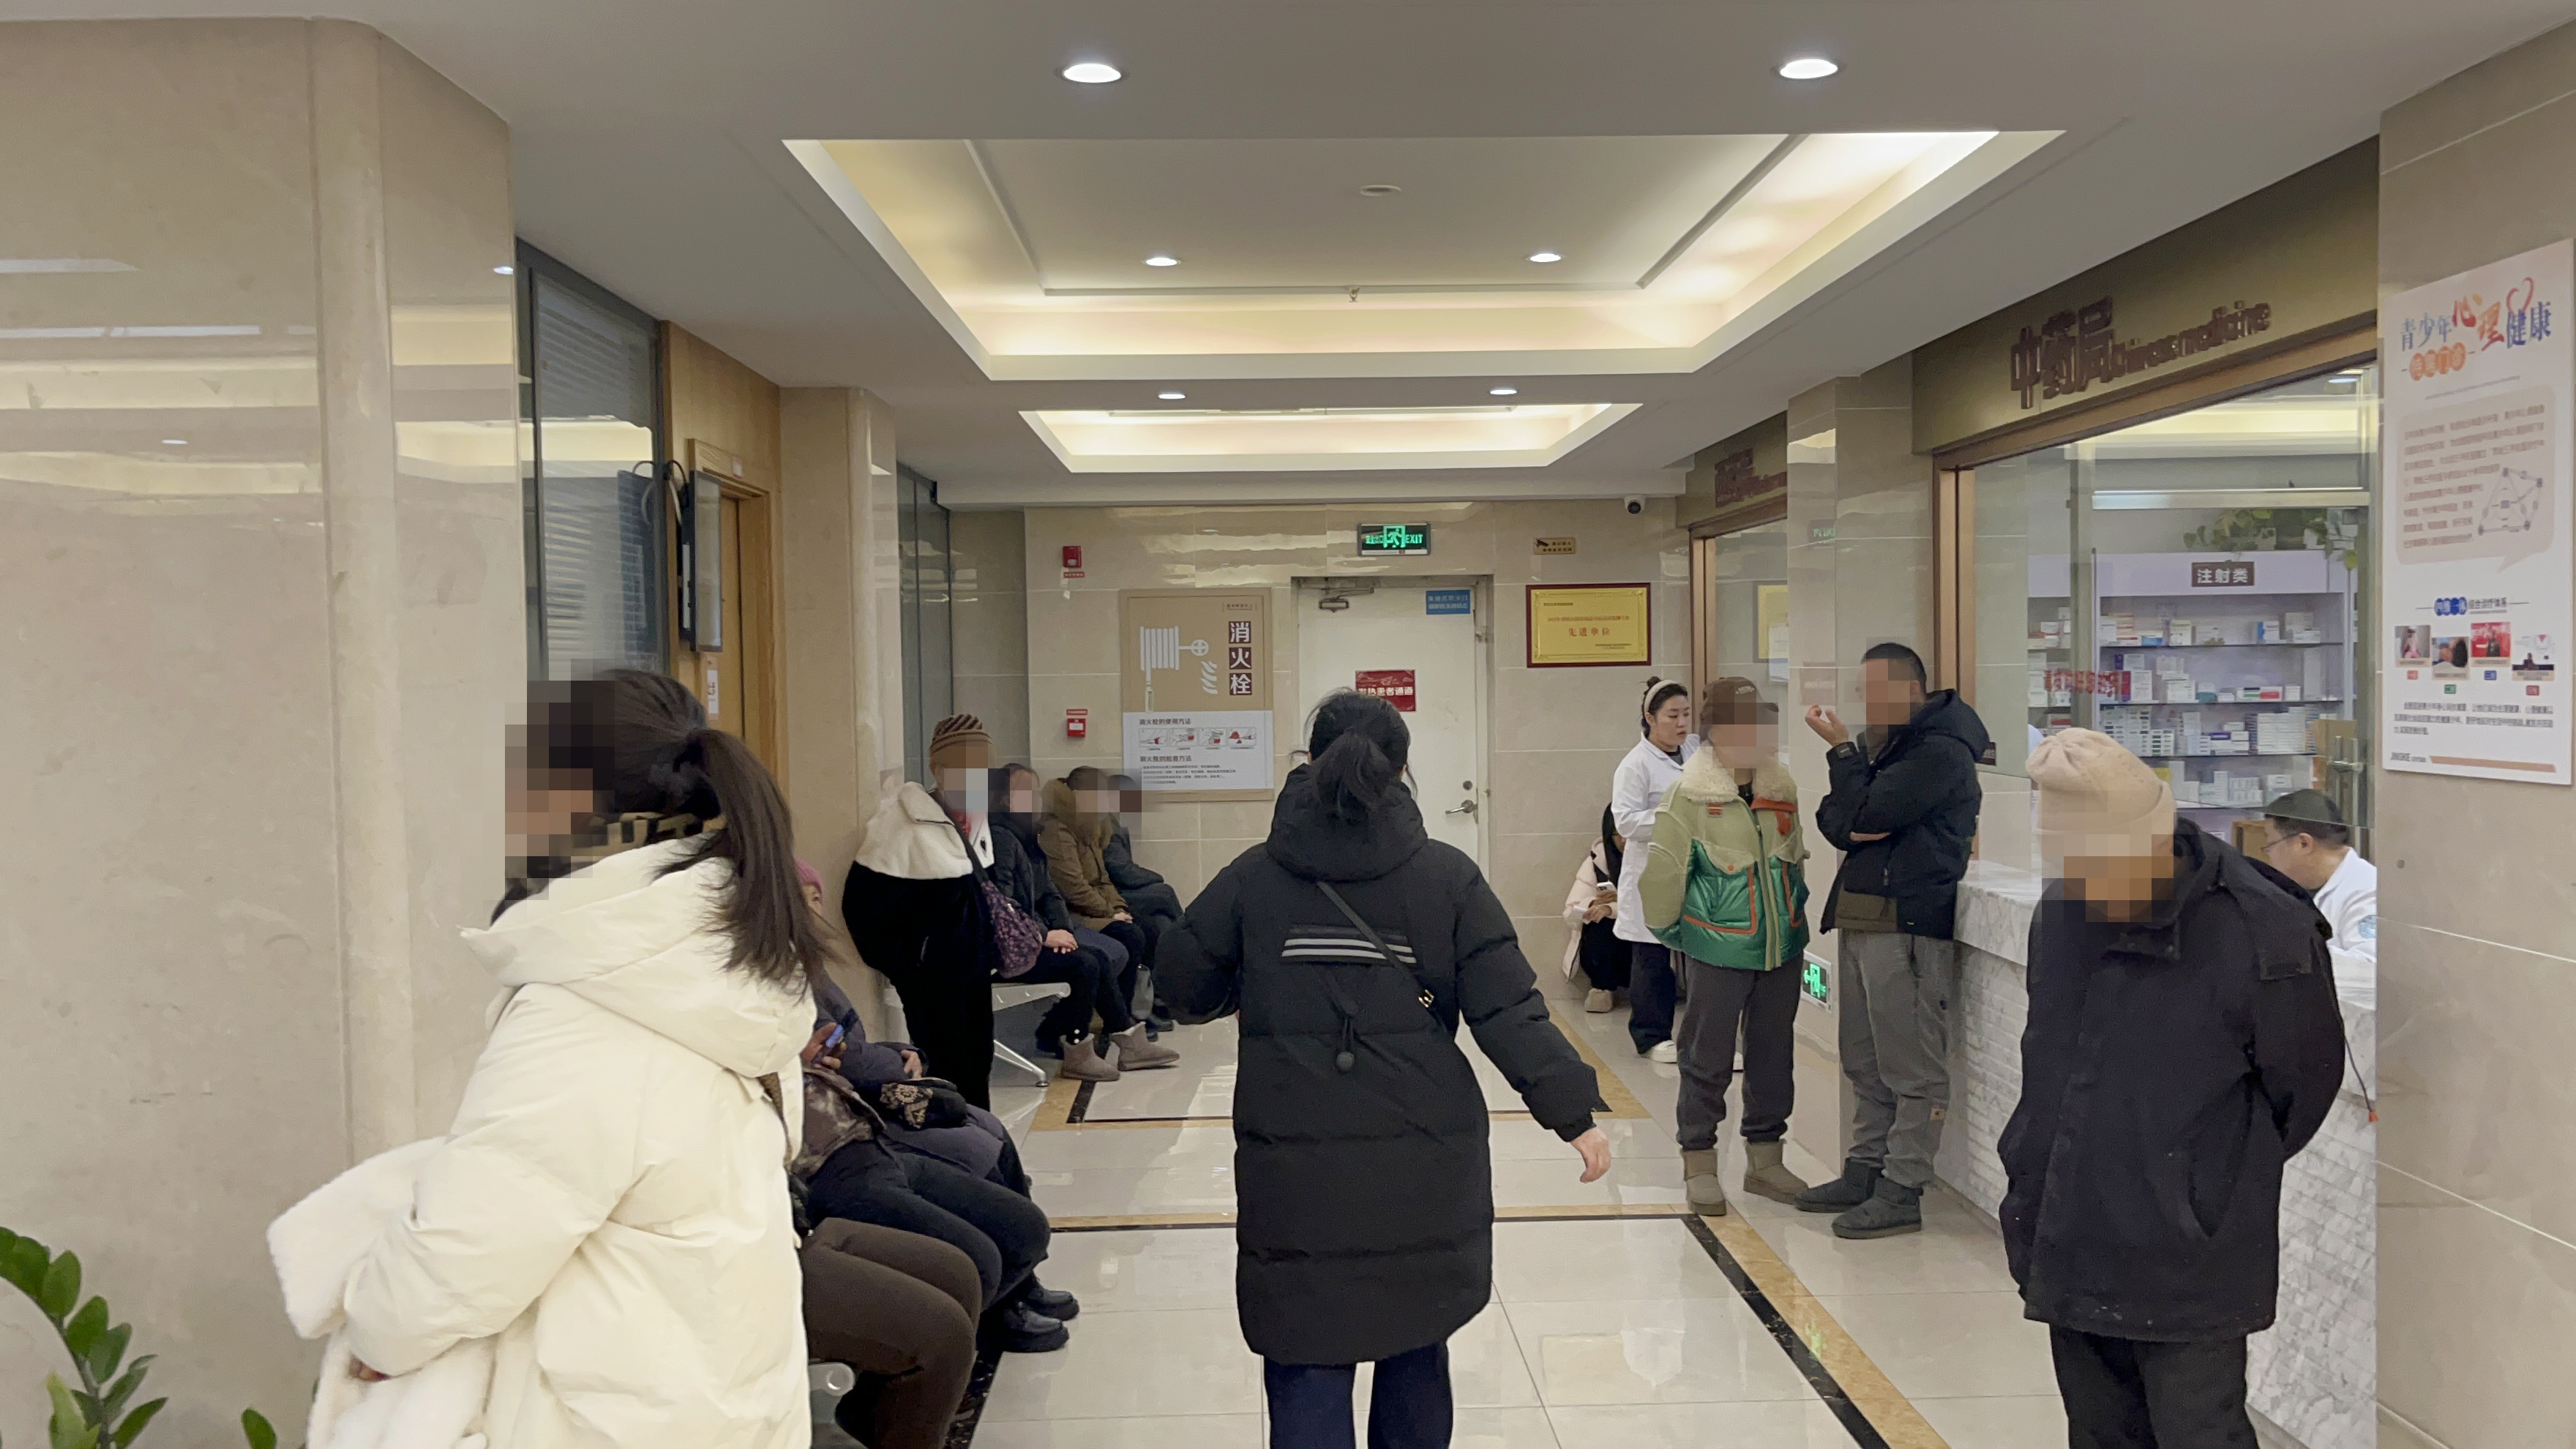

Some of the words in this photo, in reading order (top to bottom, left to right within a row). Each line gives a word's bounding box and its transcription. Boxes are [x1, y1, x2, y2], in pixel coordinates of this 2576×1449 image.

[2400, 294, 2552, 351] 青少年心理健康
[1406, 534, 1423, 544] EXIT
[2197, 568, 2248, 583] 注射类
[1229, 622, 1251, 694] 消火栓
